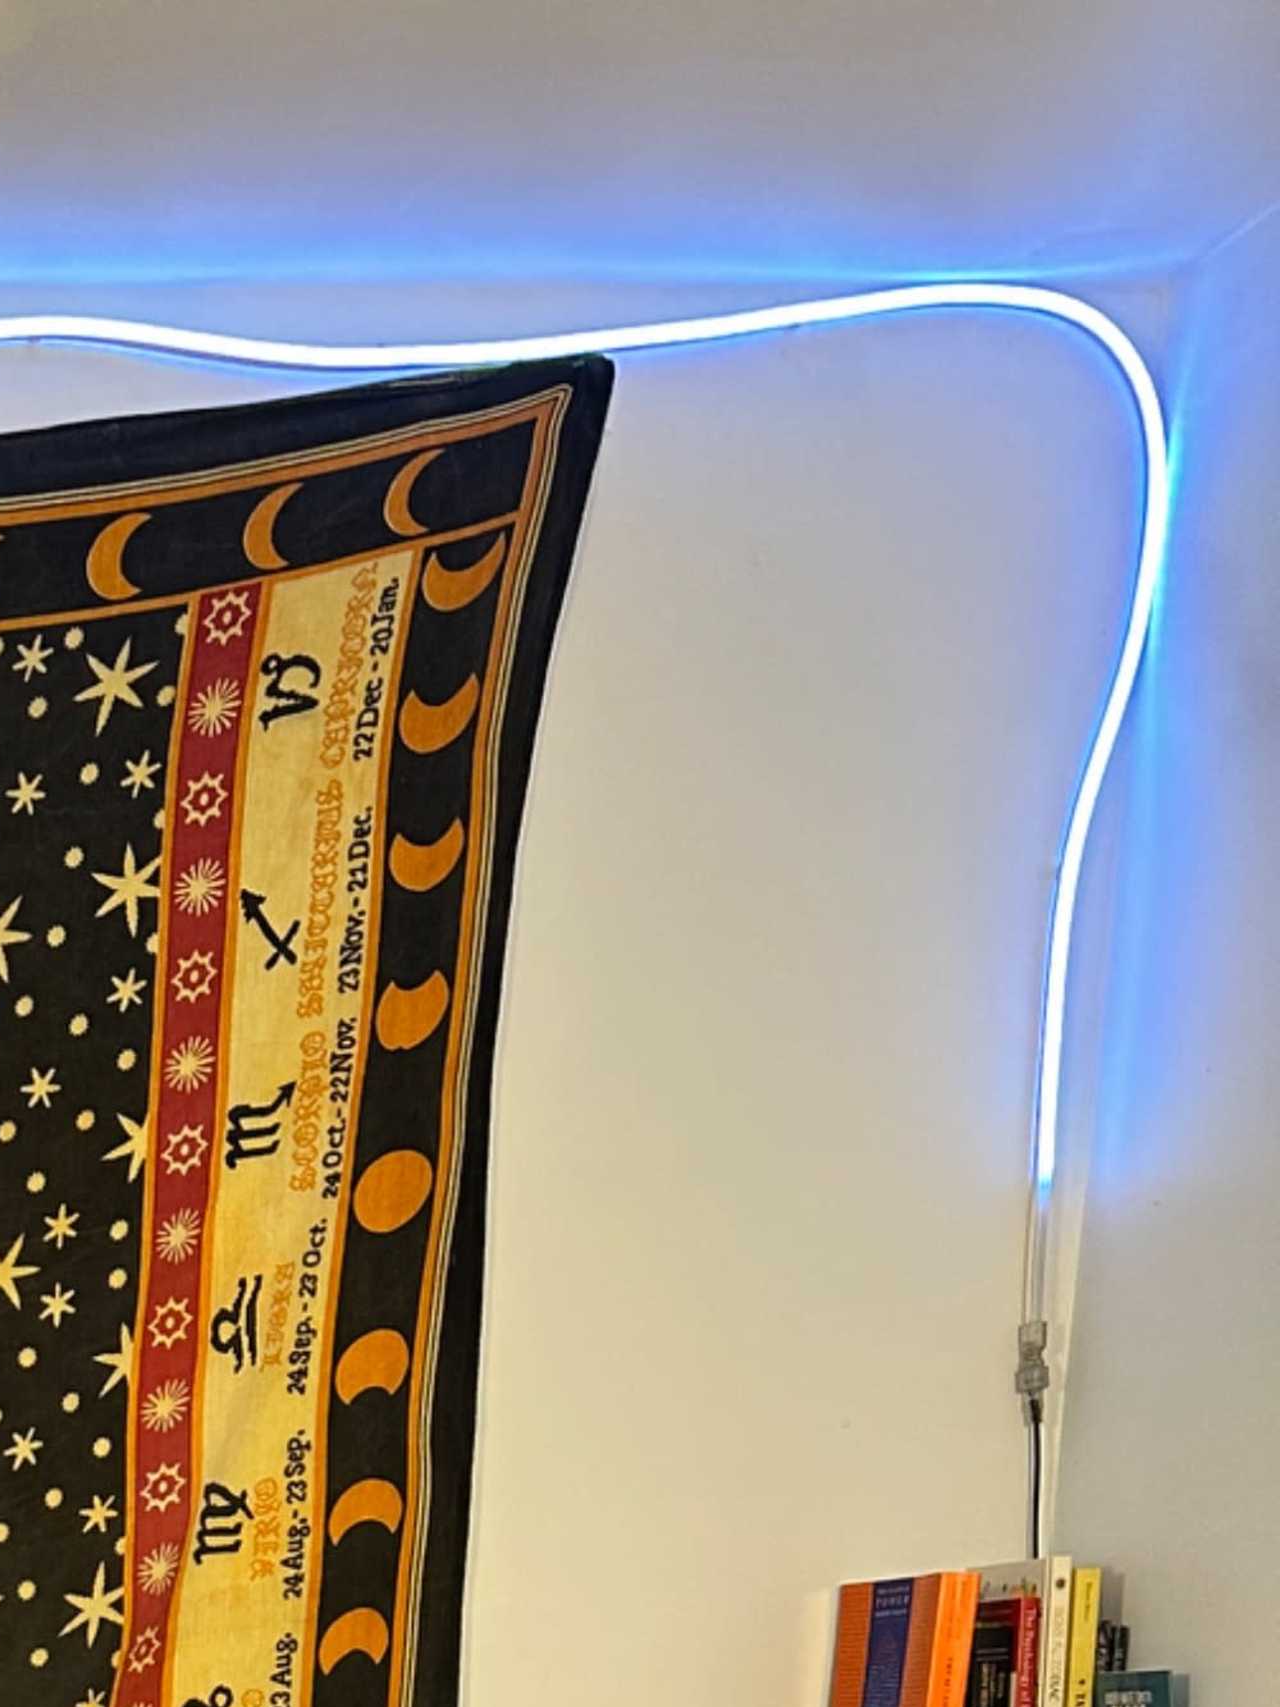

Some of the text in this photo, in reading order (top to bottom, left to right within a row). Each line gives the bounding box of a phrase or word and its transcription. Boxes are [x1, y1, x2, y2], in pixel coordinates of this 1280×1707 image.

[1025, 1608, 1036, 1627] The
[1021, 1629, 1036, 1687] Psychology
[1022, 1690, 1032, 1703] of
